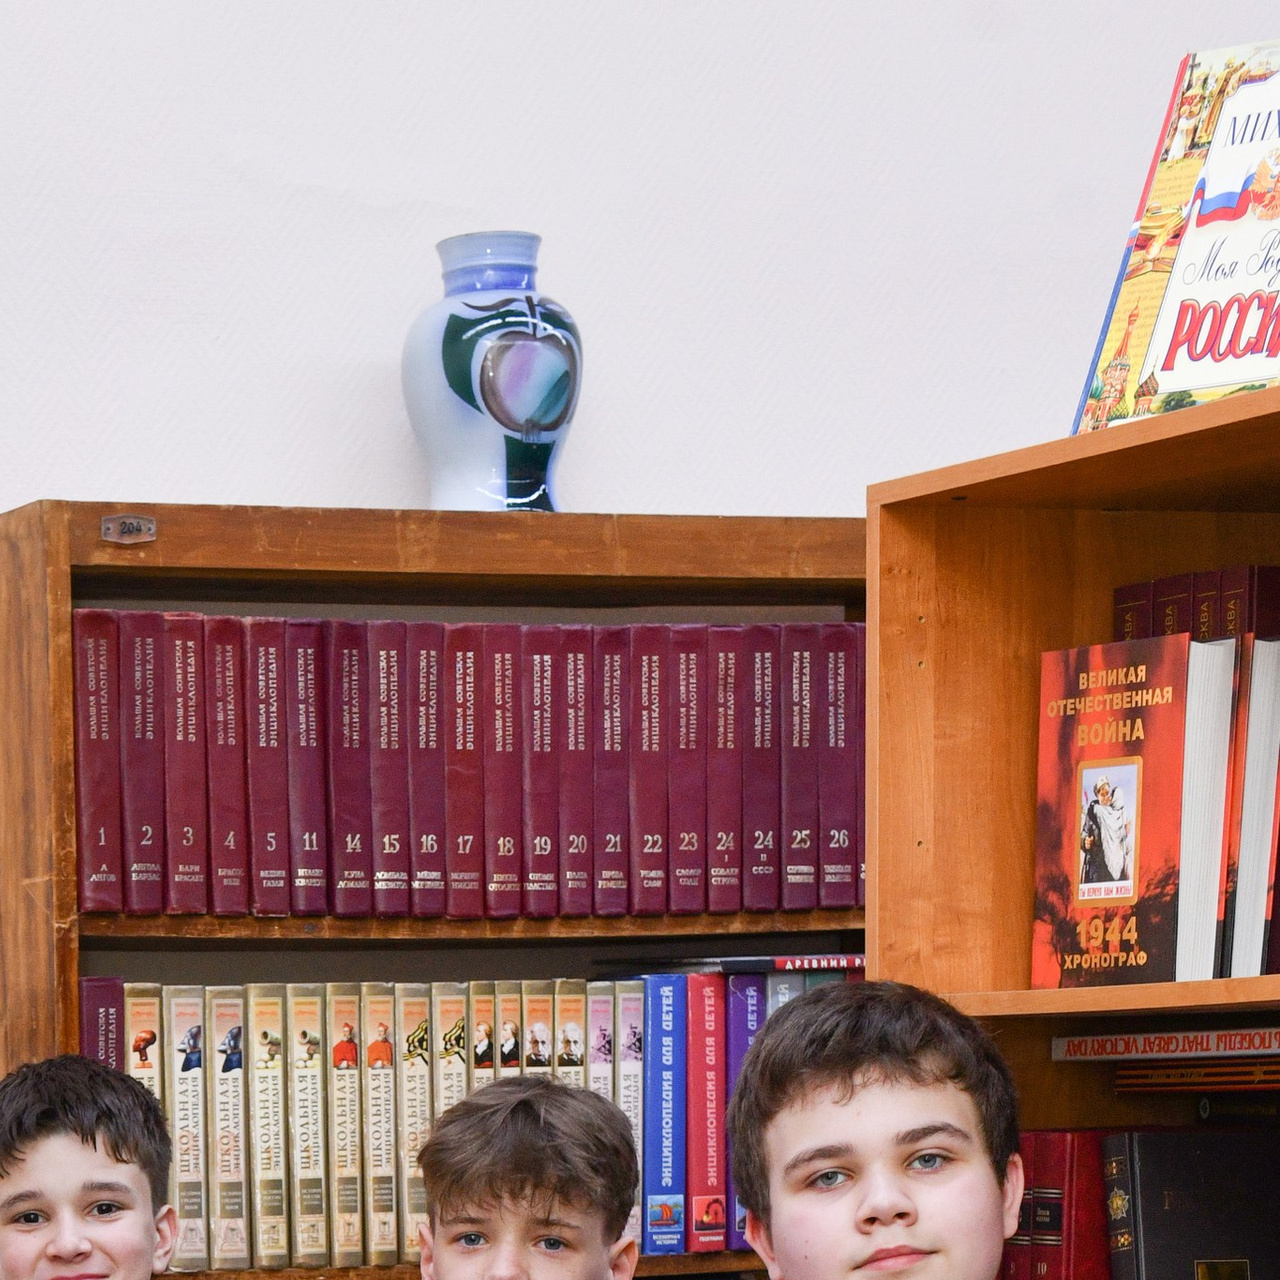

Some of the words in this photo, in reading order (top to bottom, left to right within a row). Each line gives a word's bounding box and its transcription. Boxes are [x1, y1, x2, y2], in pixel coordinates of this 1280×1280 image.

[1182, 233, 1239, 287] Моя
[1161, 288, 1280, 371] РОССИ
[120, 521, 142, 534] 204
[1078, 664, 1147, 691] ВЕЛИКАЯ
[186, 641, 196, 742] ЭНЦИКЛОПЕДИЯ
[269, 647, 277, 747] ЭНЦИКЛОПЕДИЯ
[466, 651, 474, 750] ЭНЦИКЛОПЕДИЯ
[1046, 686, 1173, 718] ОТЕЧЕСТВЕННАЯ
[1077, 717, 1145, 747] ВОЙНА
[98, 827, 105, 846] 1
[140, 825, 152, 845] 2
[183, 826, 194, 846] 3
[224, 831, 236, 849] 4
[267, 832, 276, 851] 5
[303, 831, 318, 850] 11
[345, 833, 362, 853] 14
[383, 834, 400, 853] 15
[420, 834, 437, 853] 16
[457, 835, 473, 853] 17
[568, 834, 587, 853] 20
[605, 834, 622, 852] 21
[643, 834, 662, 853] 22
[679, 832, 698, 851] 23
[716, 832, 735, 850] 24
[754, 830, 774, 849] 24
[791, 830, 811, 848] 25
[829, 829, 848, 847] 26
[497, 837, 514, 856] 18
[534, 836, 551, 855] 19
[100, 863, 108, 872] А
[1075, 915, 1138, 947] 1944
[785, 956, 848, 970] ДРЕВНИЙ
[1063, 950, 1148, 971] ХРОНОГРАФ
[660, 985, 673, 1031] ДЕТЕЙ
[703, 986, 716, 1031] ДЕТЕЙ
[745, 985, 758, 1031] ДЕТЕЙ
[661, 1036, 673, 1066] ДЛЯ
[705, 1036, 716, 1066] ДЛЯ
[1065, 1040, 1088, 1057] DAY
[1089, 1036, 1141, 1056] VICTORY
[1141, 1034, 1180, 1054] GREAT
[1181, 1034, 1211, 1054] THAT
[1216, 1032, 1272, 1052] ПОБЕДЫ
[260, 1075, 272, 1171] ШКОЛЬНАЯ
[336, 1073, 348, 1169] ШКОЛЬНАЯ
[371, 1072, 382, 1169] ШКОЛЬНАЯ
[661, 1070, 673, 1187] ЭНЦИКЛОПЕДИЯ
[706, 1070, 717, 1187] ЭНЦИКЛОПЕДИЯ
[1036, 1262, 1047, 1275] 10
